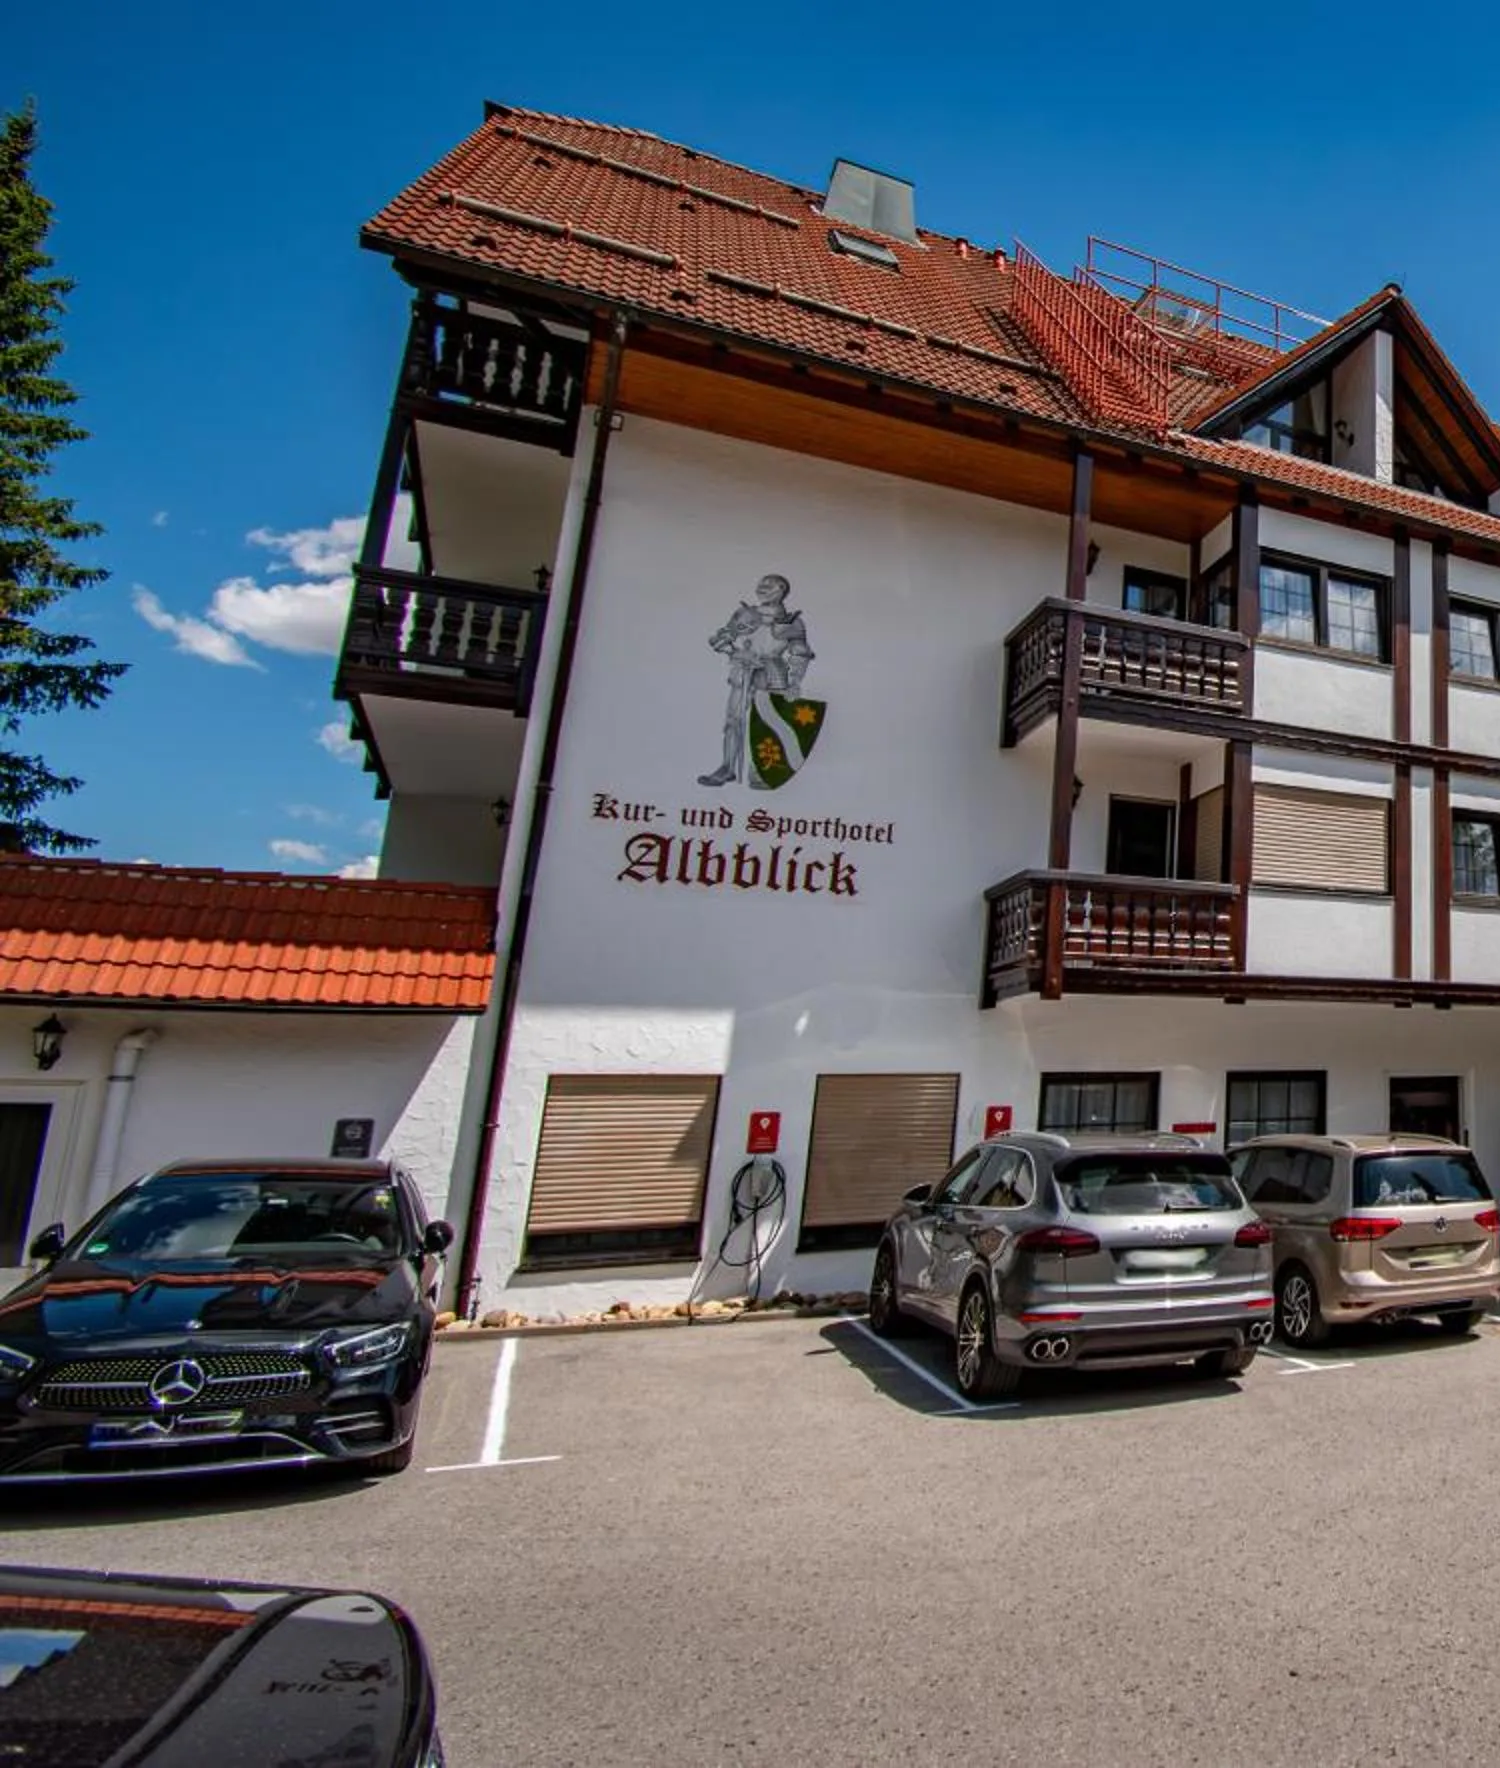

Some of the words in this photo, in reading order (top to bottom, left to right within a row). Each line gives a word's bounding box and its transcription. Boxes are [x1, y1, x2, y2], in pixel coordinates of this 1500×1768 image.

[592, 793, 666, 822] Kur-
[681, 807, 733, 829] und
[746, 809, 896, 844] Sporthotel
[617, 832, 858, 896] Albblick
